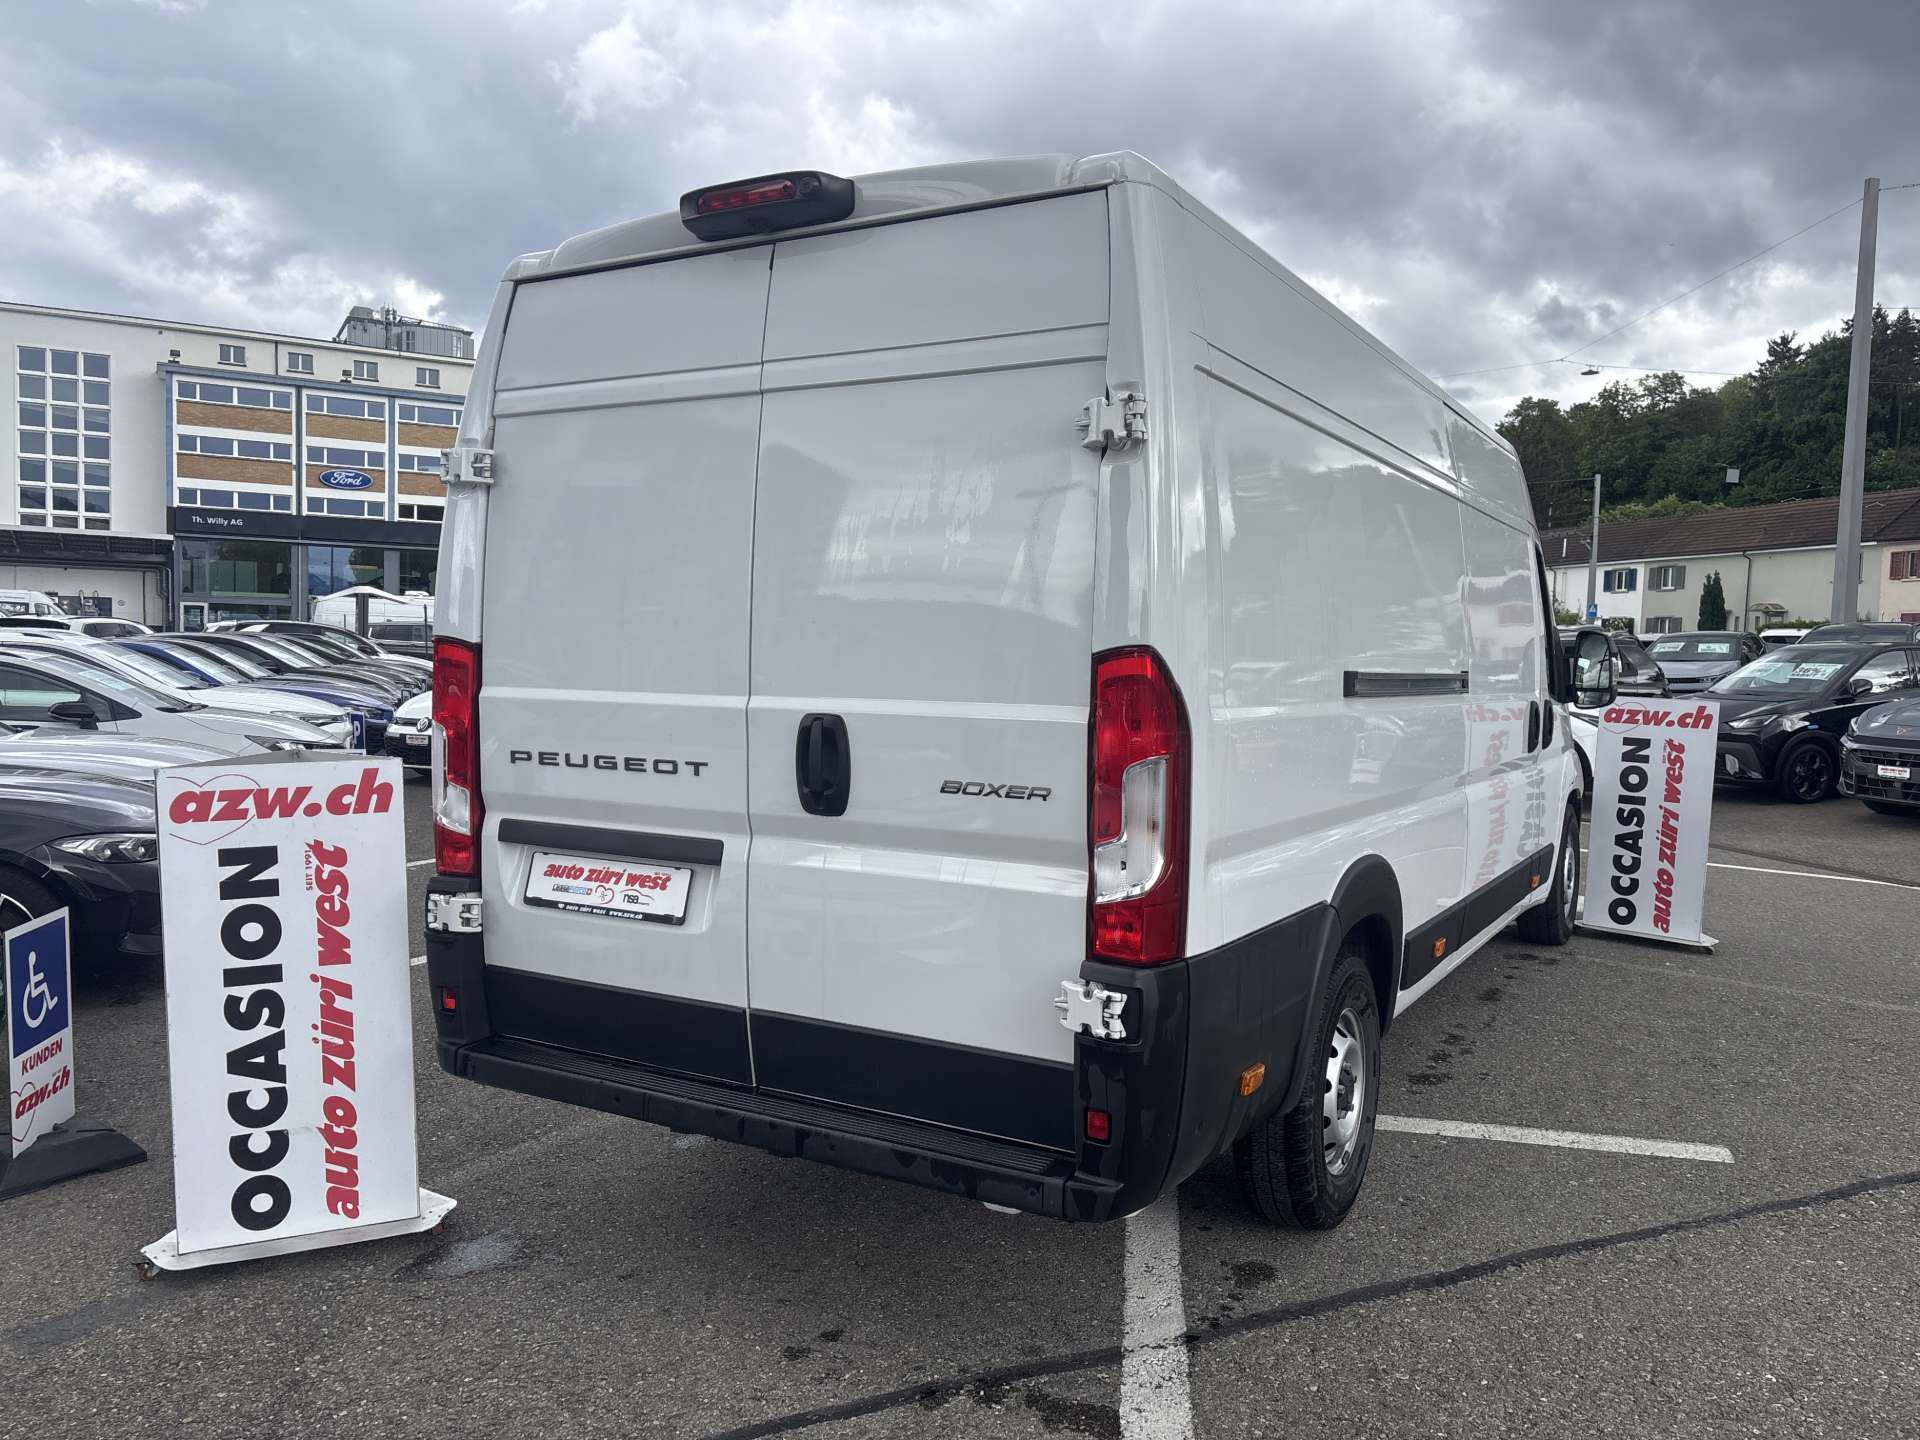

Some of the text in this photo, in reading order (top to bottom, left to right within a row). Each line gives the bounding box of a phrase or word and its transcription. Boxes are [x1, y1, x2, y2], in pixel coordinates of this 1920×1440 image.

[330, 471, 362, 486] Ford
[206, 516, 228, 527] Willy
[230, 518, 243, 526] AG
[1604, 706, 1714, 729] azw.ch
[510, 750, 708, 776] PEUGEOT
[169, 767, 393, 824] azw.ch
[940, 780, 1051, 801] BOXER
[1608, 736, 1652, 925] OCCASION
[1653, 738, 1686, 934] auto züri west
[304, 849, 313, 891] SEIT 1991
[544, 863, 672, 891] auto züri west
[623, 893, 639, 904] nsa
[218, 846, 291, 1231] OCCASION
[304, 839, 360, 1219] auto züri west
[22, 1037, 63, 1076] KUNDEN
[15, 1065, 71, 1119] azw.ch
